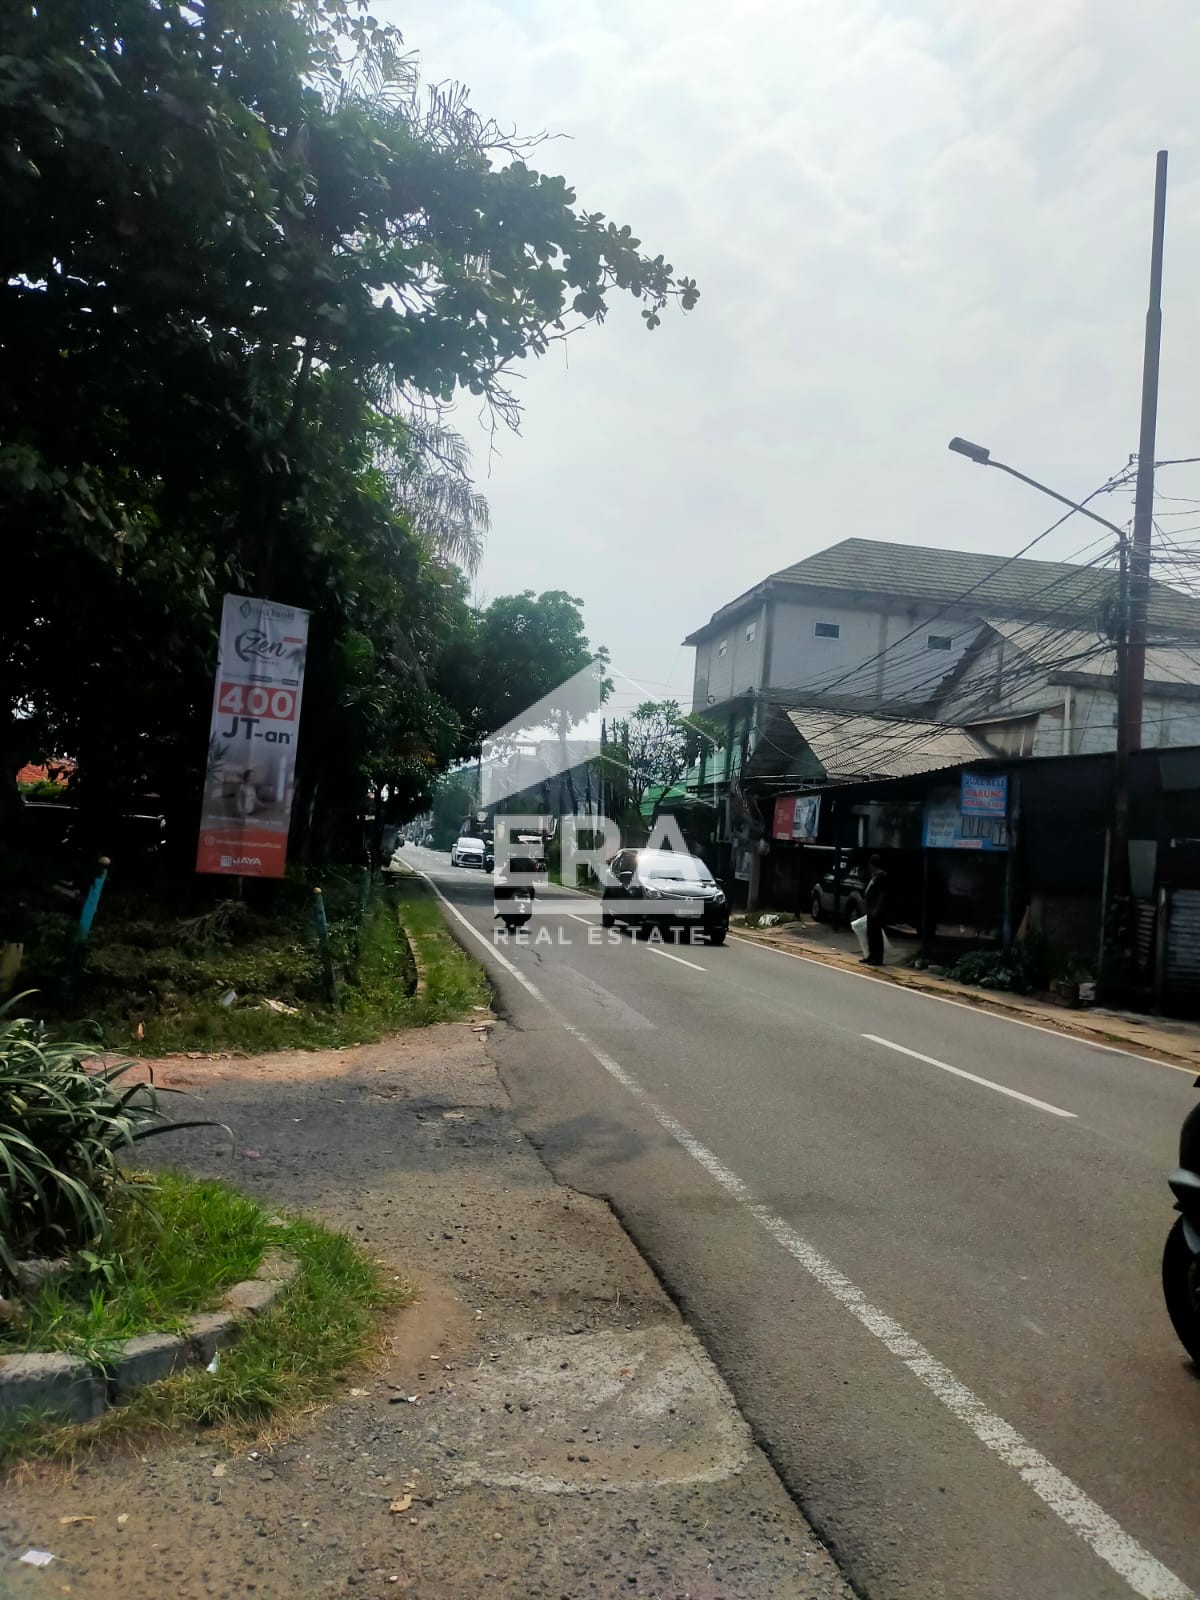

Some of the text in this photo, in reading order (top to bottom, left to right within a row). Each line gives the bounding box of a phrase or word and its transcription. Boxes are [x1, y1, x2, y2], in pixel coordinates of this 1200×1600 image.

[241, 635, 287, 660] Zen
[220, 686, 294, 718] 400
[232, 855, 262, 866] JAYA
